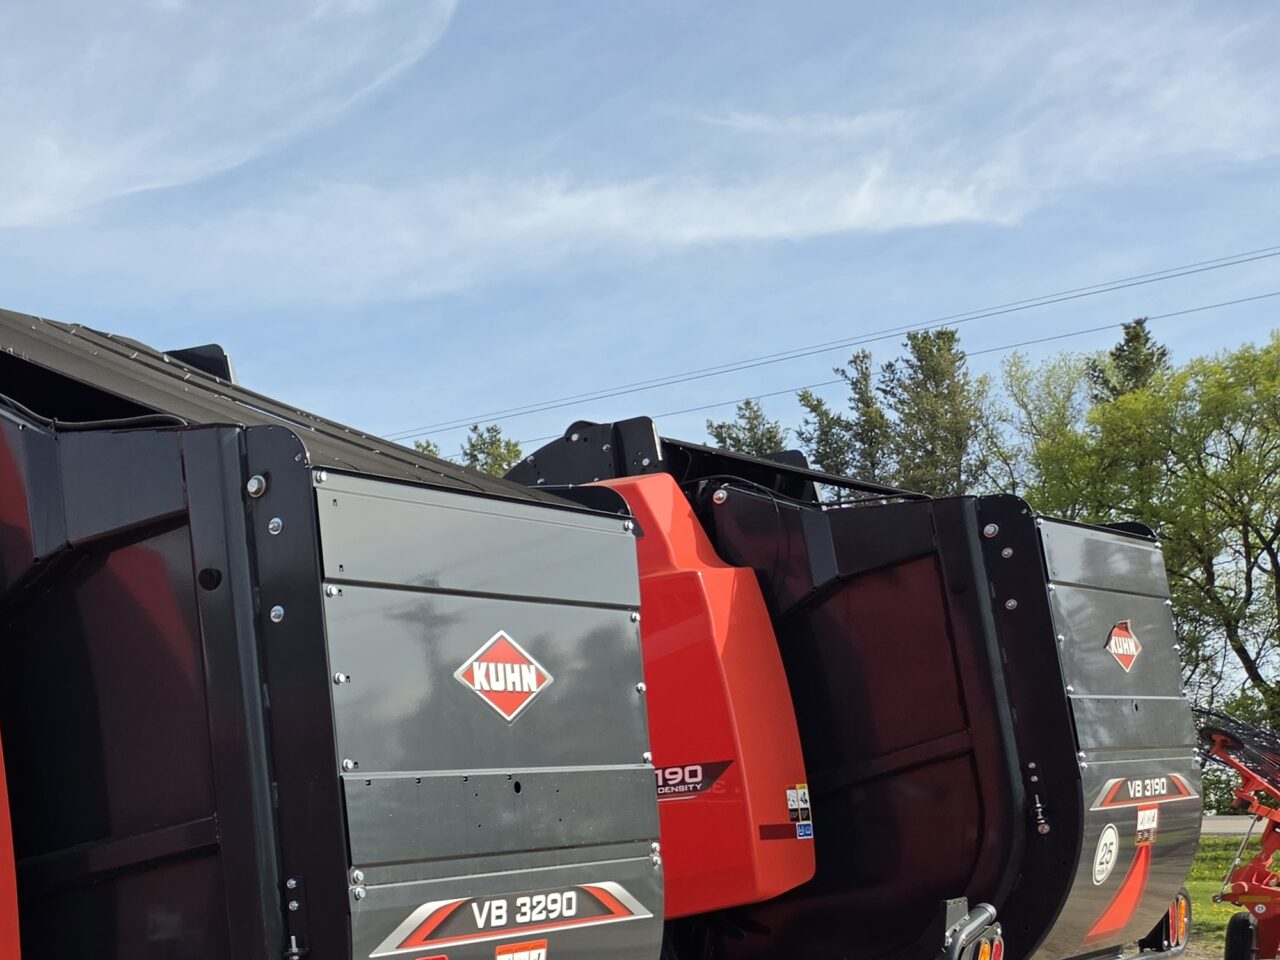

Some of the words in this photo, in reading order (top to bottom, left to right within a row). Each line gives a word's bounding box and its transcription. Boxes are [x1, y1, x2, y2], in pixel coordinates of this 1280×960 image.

[1111, 637, 1136, 655] KUHN
[472, 662, 537, 692] KUHN
[658, 784, 702, 793] DENSITY
[1127, 780, 1143, 798] VB
[1144, 778, 1167, 796] 3190
[1098, 842, 1114, 866] 25
[471, 899, 507, 928] VB
[516, 891, 576, 923] 3290
